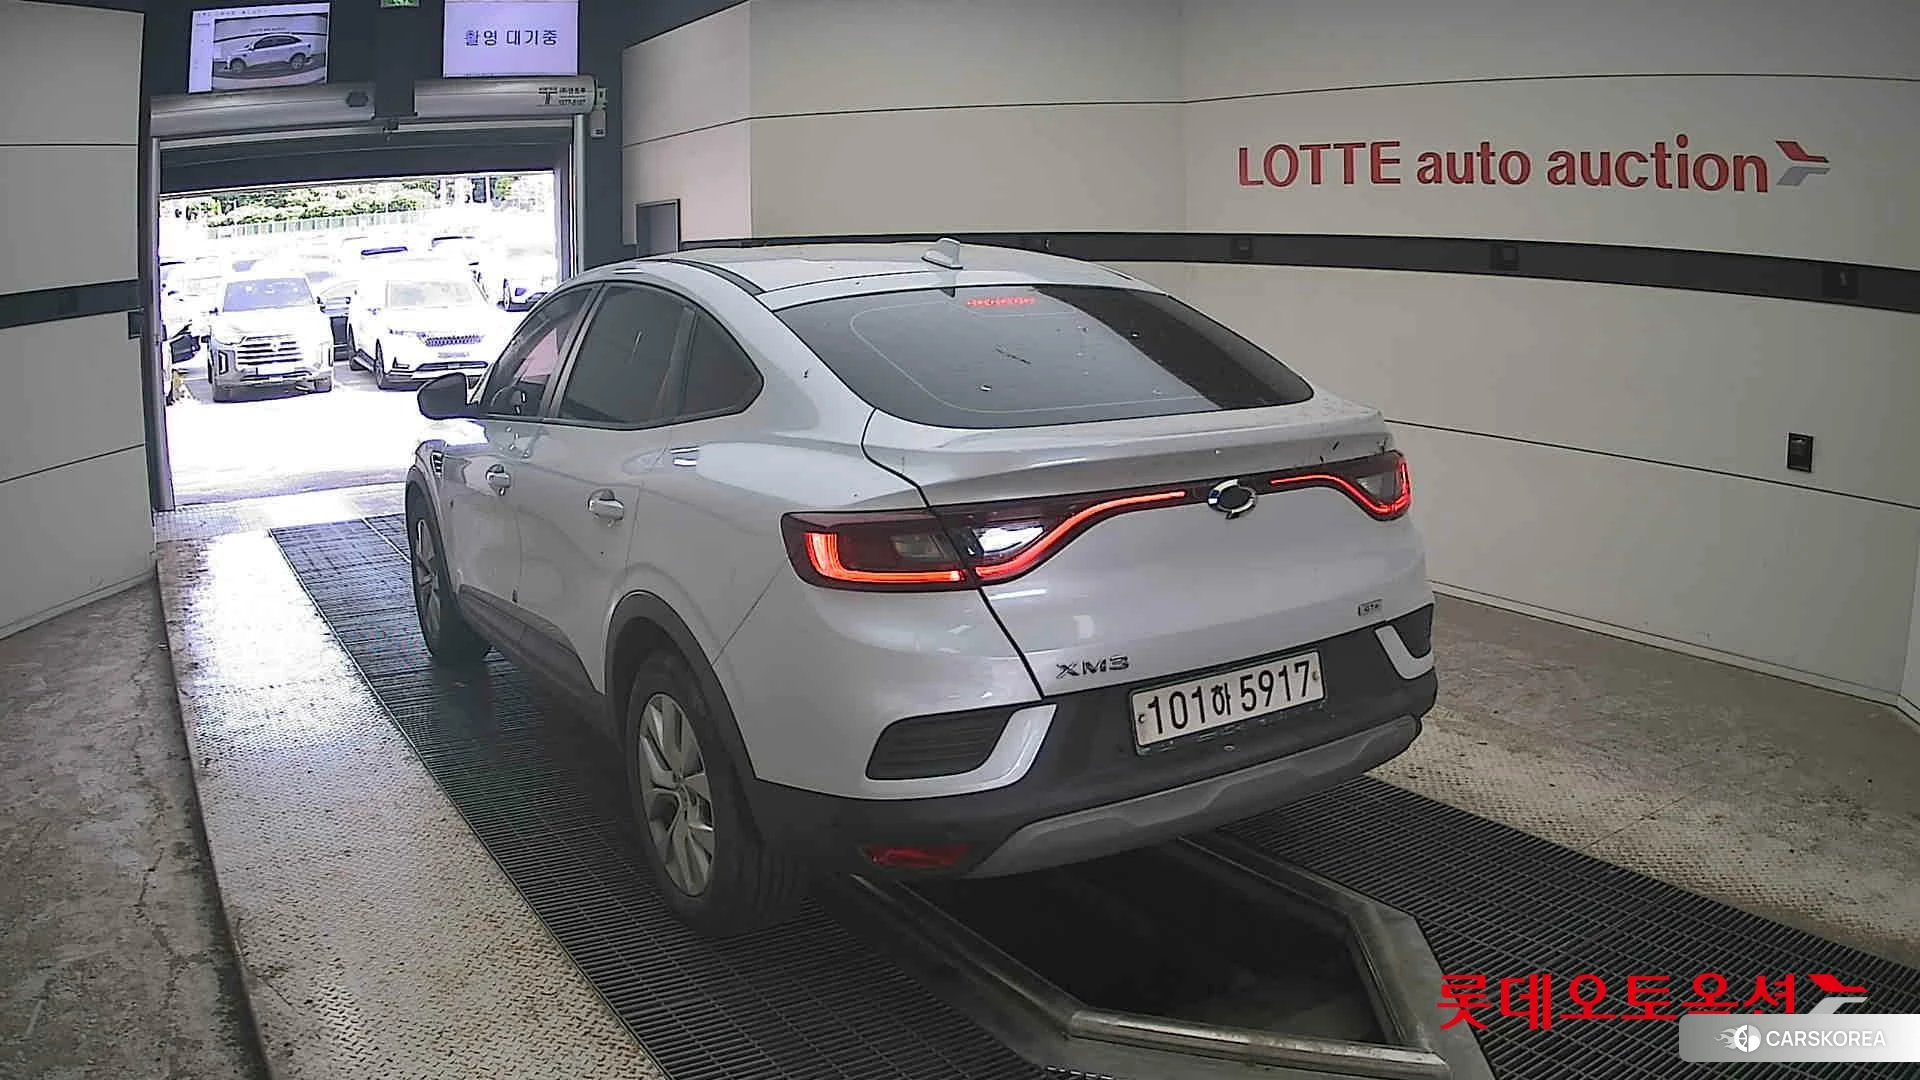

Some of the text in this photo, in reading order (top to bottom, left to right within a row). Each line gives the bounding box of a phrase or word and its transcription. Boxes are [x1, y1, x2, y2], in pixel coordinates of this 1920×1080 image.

[506, 29, 558, 46] 대기중
[1238, 133, 1769, 193] LOTTE auto auction
[1056, 655, 1129, 679] XM3
[1147, 660, 1310, 735] 101하 5917
